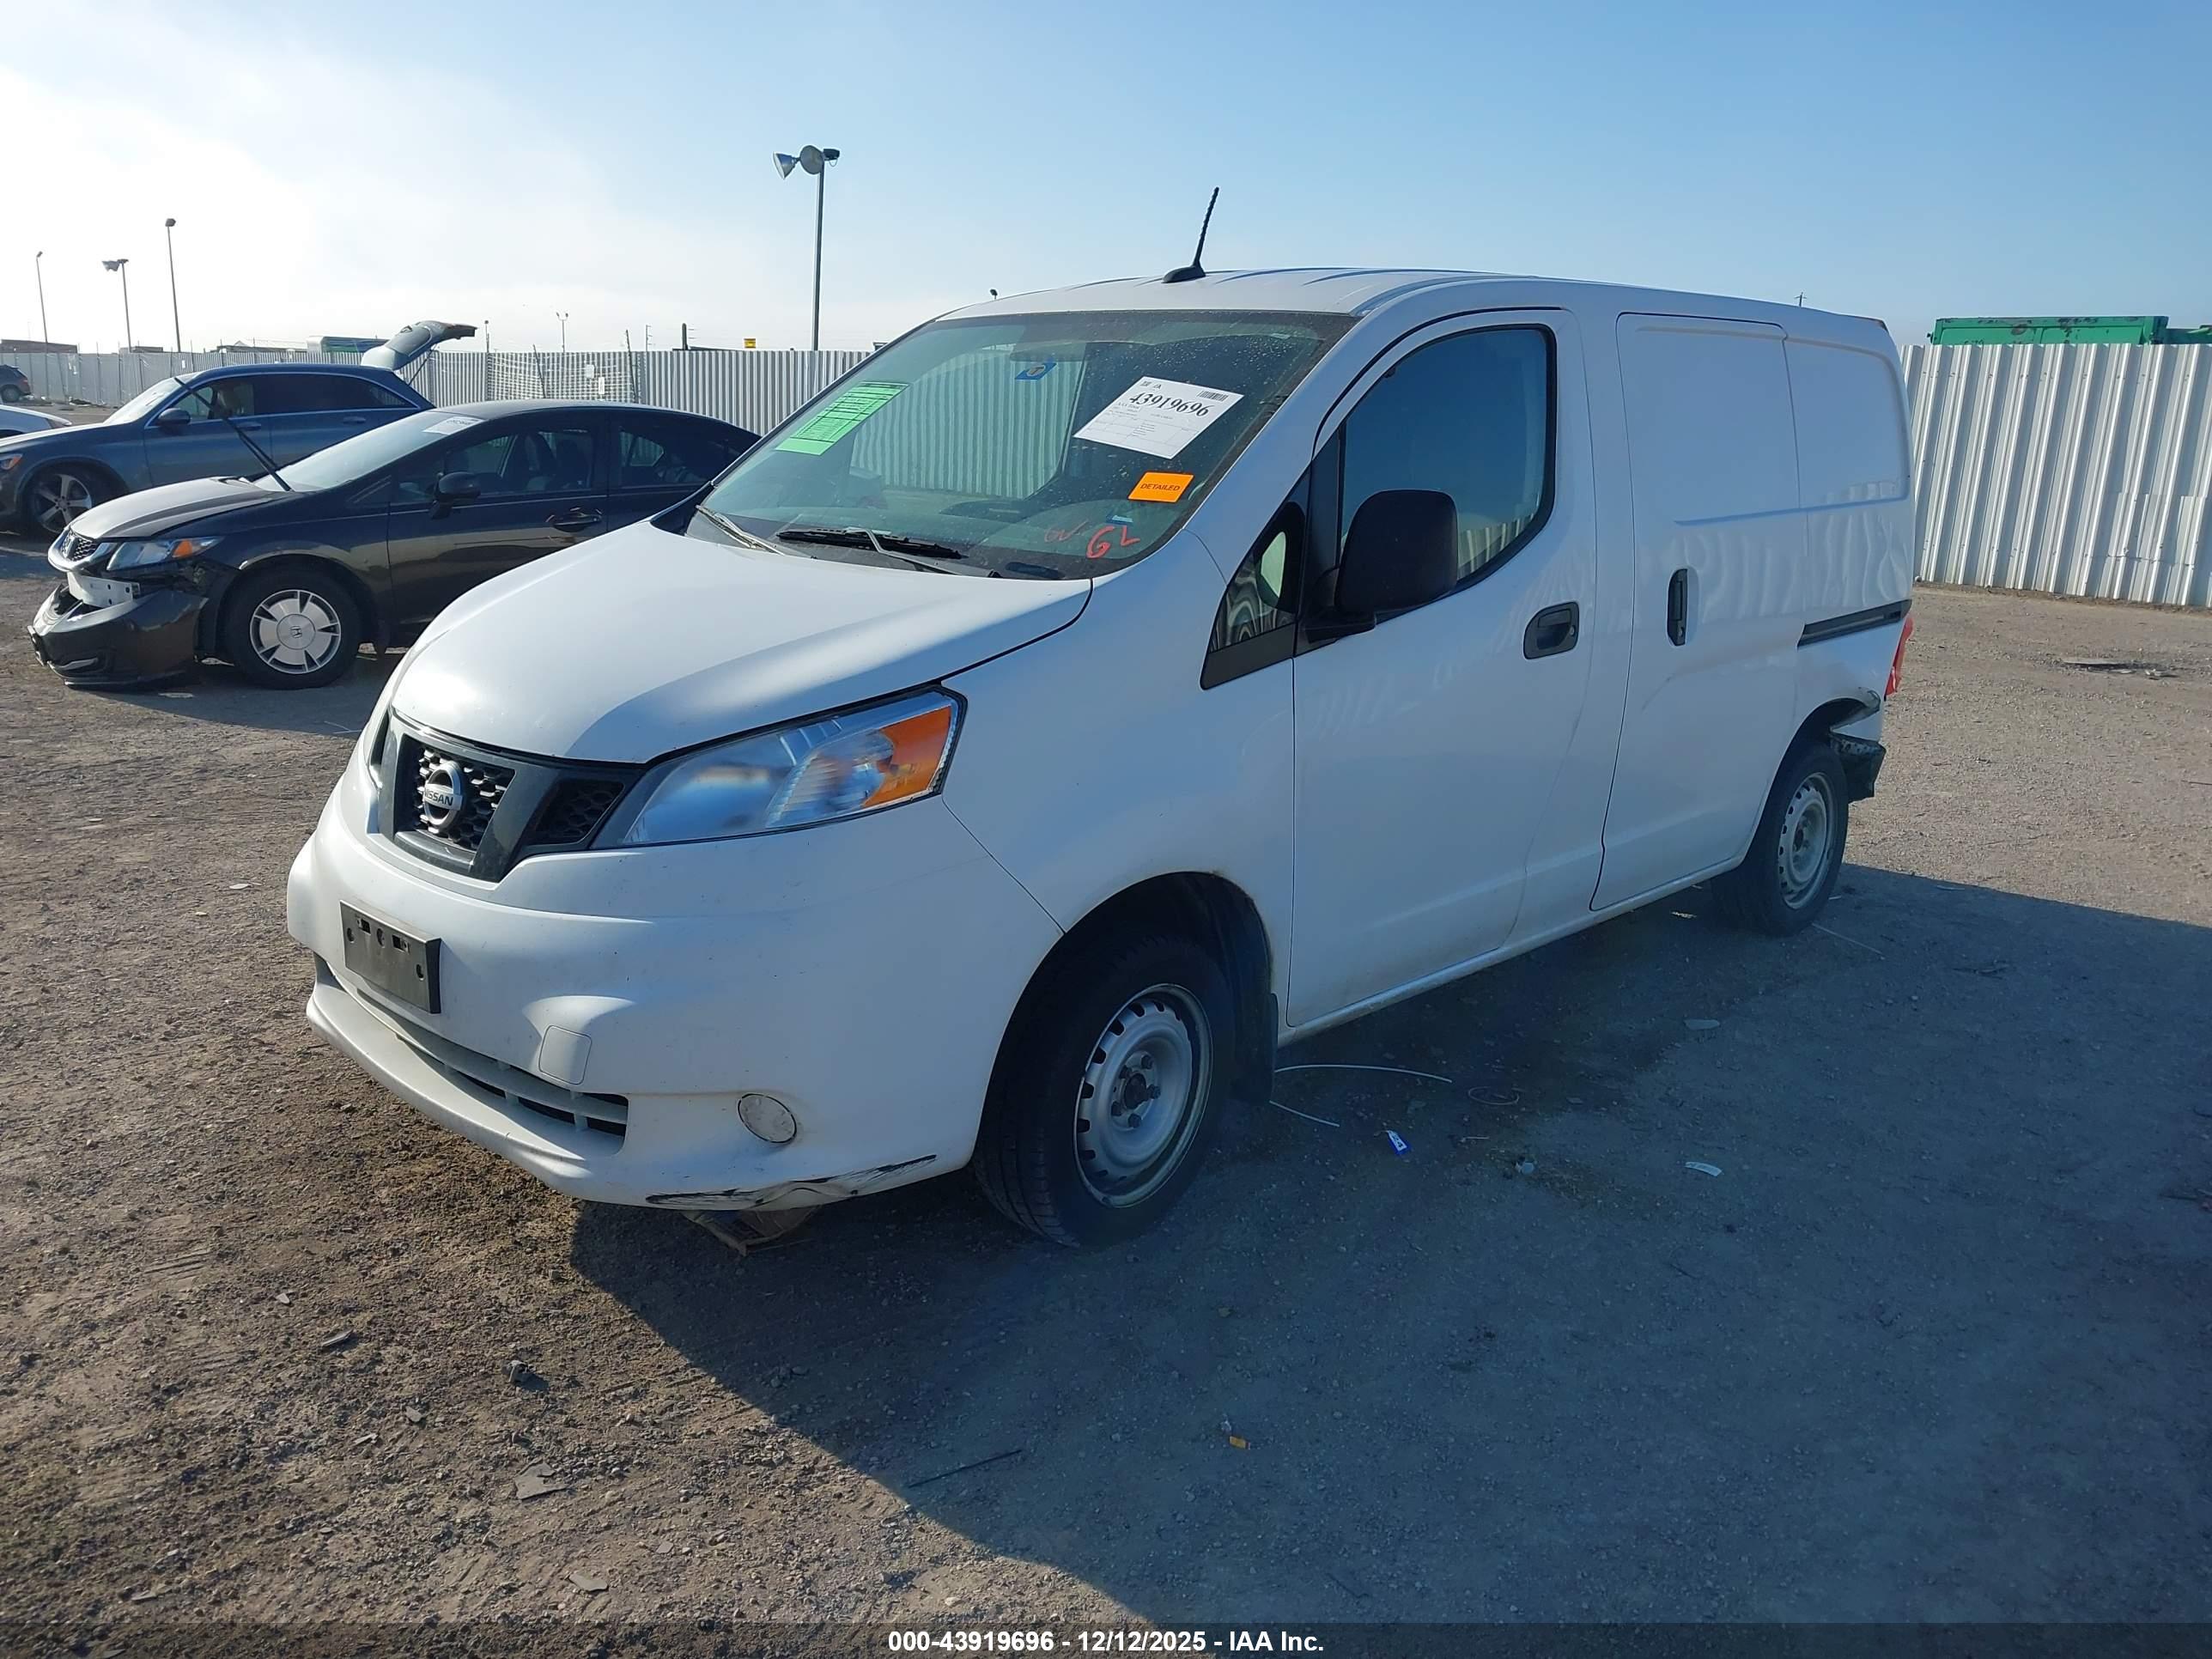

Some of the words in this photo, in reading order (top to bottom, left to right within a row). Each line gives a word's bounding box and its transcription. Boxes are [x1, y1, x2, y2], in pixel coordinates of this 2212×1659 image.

[1129, 392, 1211, 417] 43919696
[1139, 483, 1181, 492] DETAILED
[424, 789, 453, 805] NISSAN
